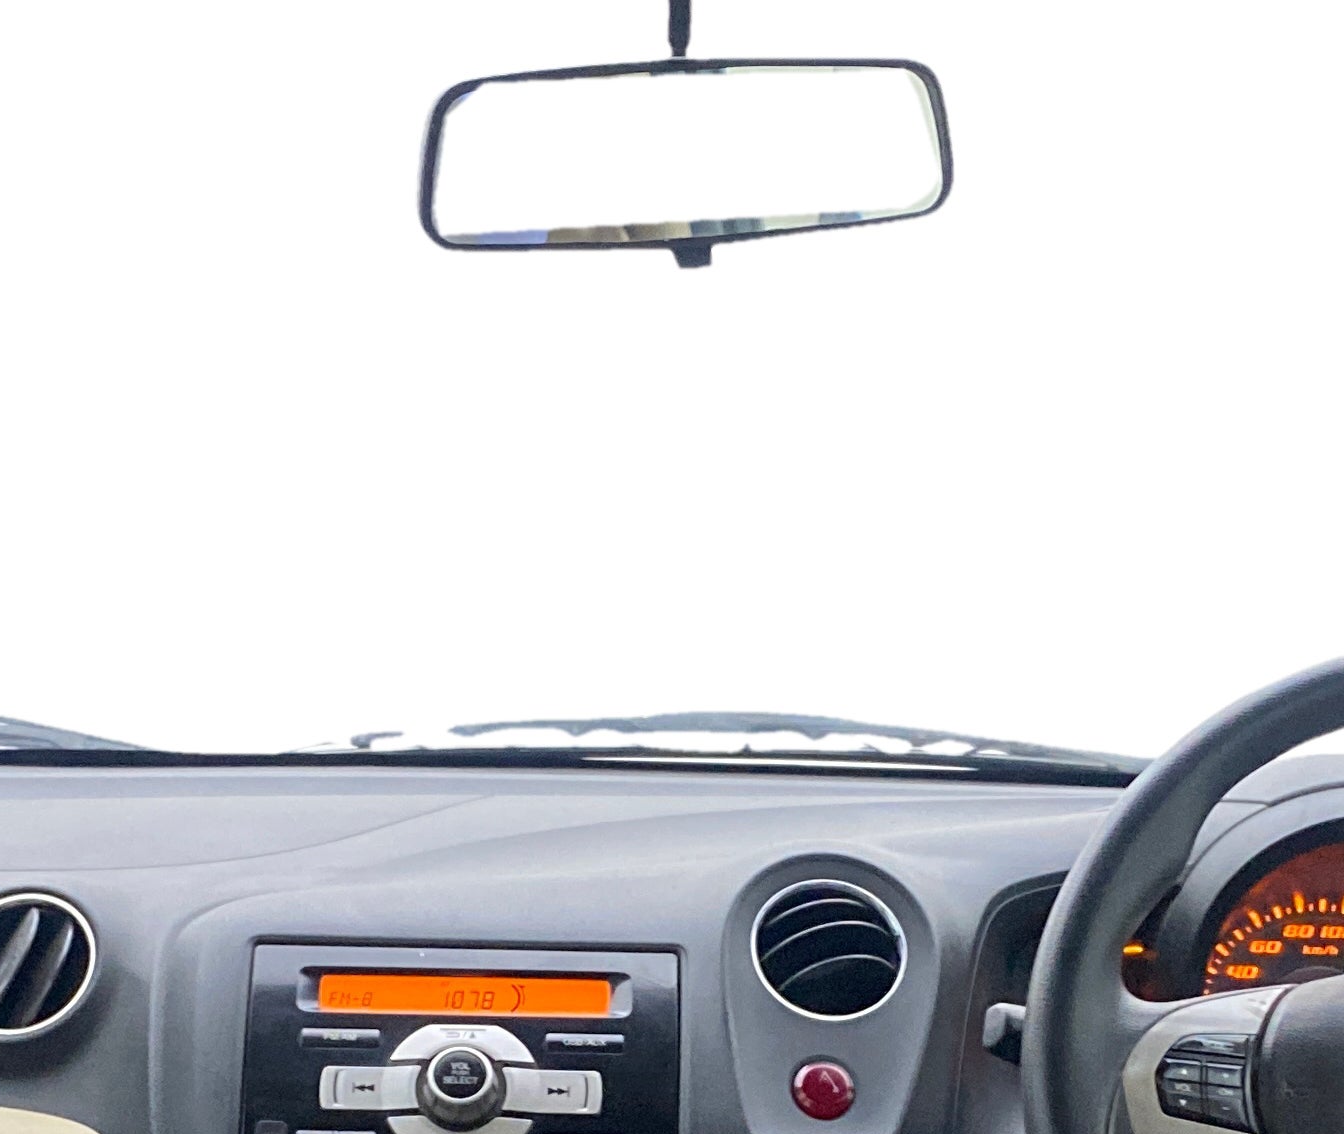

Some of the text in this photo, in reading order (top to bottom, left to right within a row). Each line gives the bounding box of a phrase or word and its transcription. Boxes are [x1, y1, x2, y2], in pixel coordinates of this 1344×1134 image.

[1283, 924, 1316, 939] 80
[1248, 940, 1283, 954] 60
[1225, 964, 1259, 979] 40
